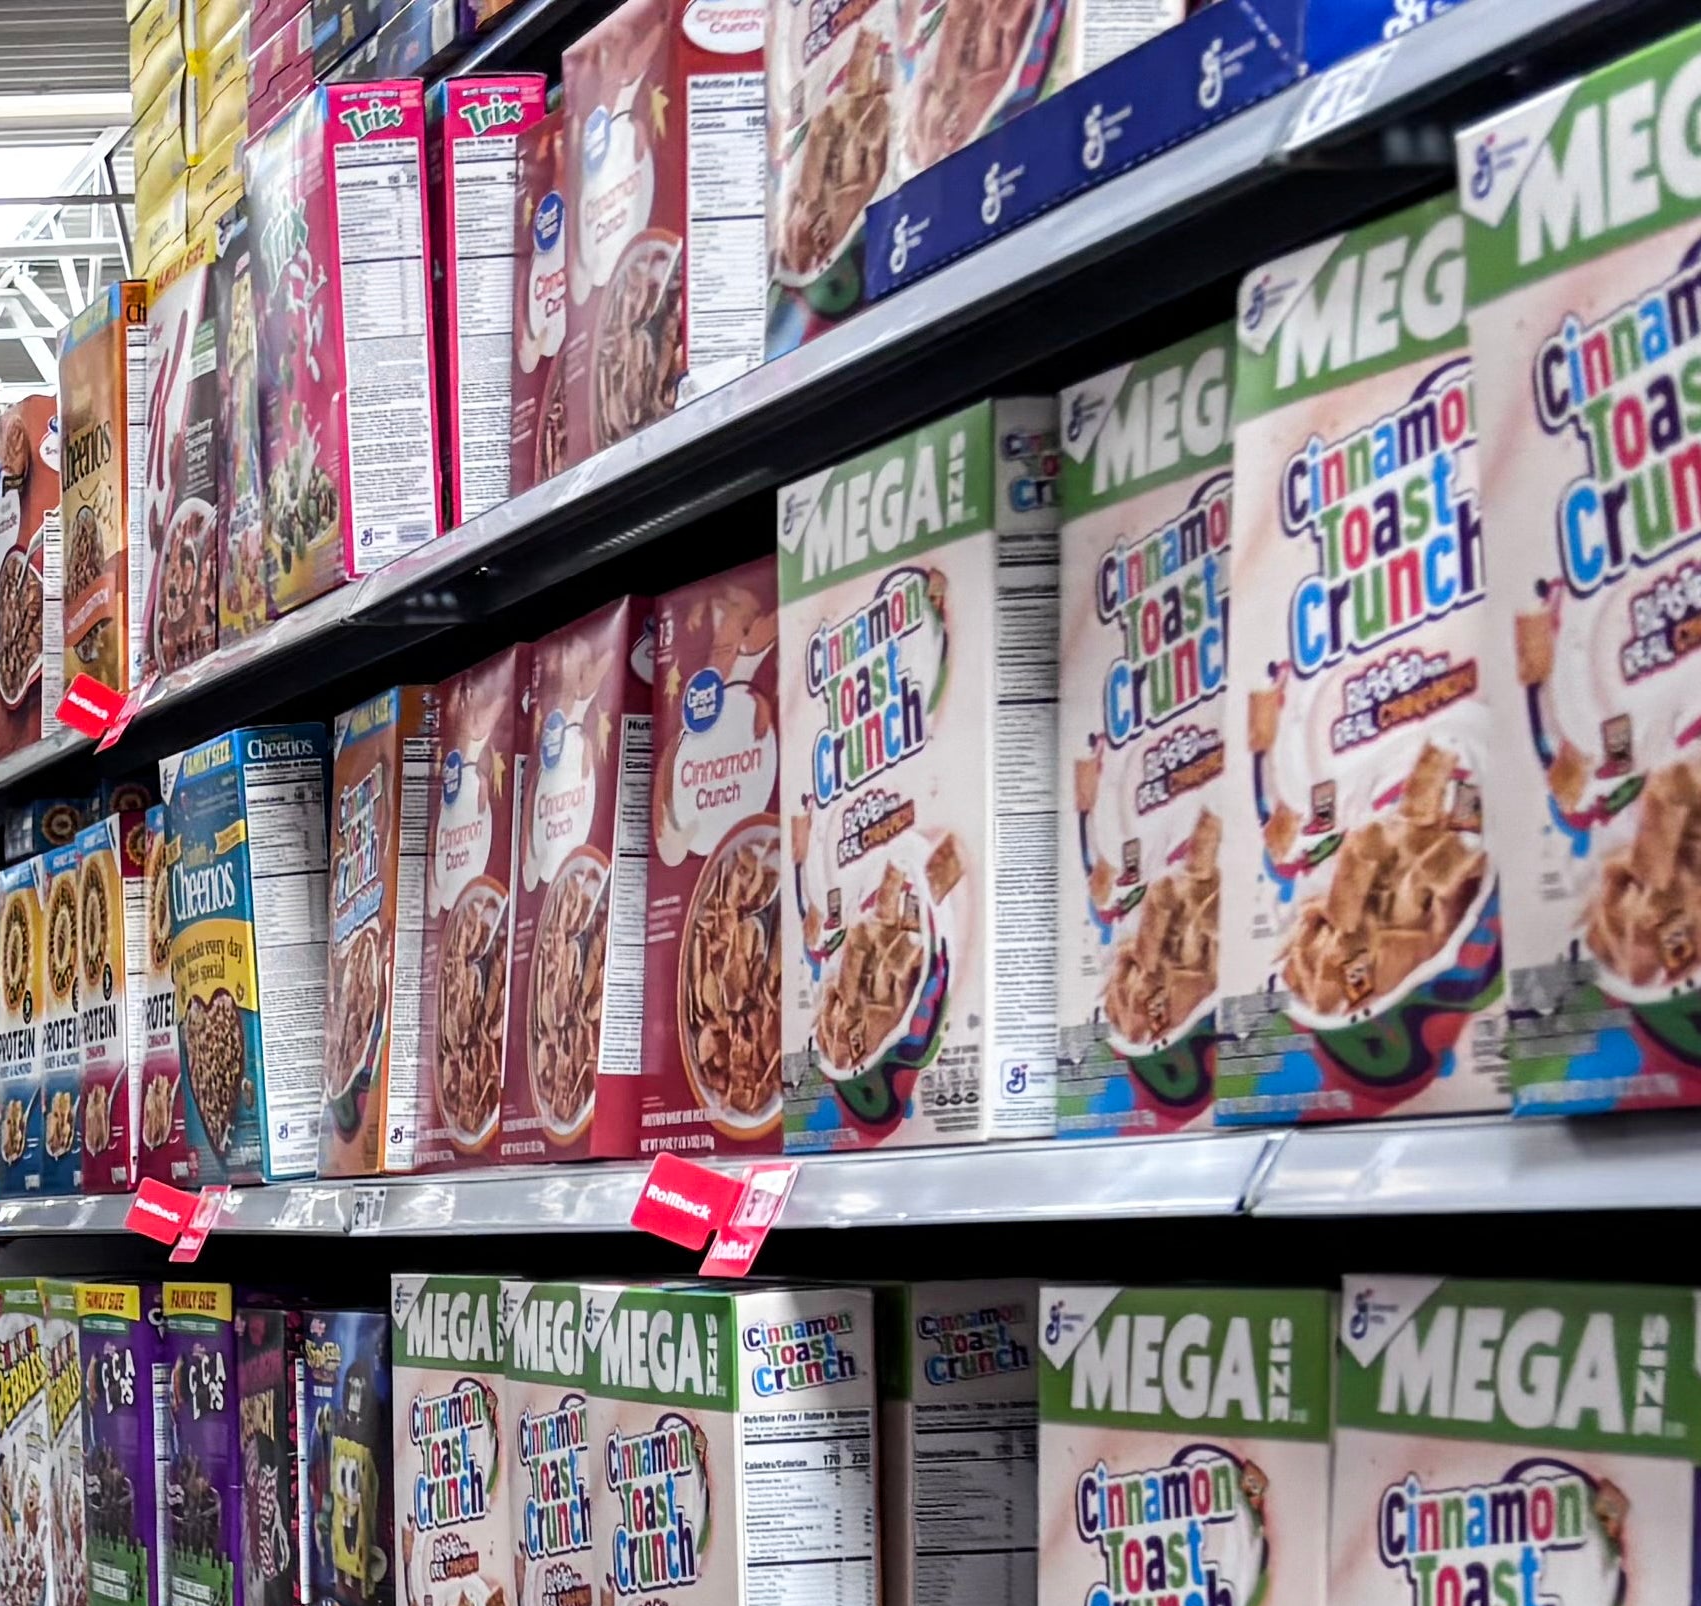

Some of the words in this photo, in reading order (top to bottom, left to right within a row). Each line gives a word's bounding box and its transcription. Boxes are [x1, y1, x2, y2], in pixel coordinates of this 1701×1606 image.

[339, 98, 403, 141] Trix
[459, 94, 524, 136] Trix
[1275, 216, 1465, 389] MEG
[1321, 448, 1451, 582] Toast
[807, 570, 925, 690] Cinnamon
[688, 685, 717, 709] Great
[828, 637, 900, 732] Toast
[1346, 655, 1421, 713] BLASTED
[248, 739, 314, 759] Cheerios
[681, 748, 762, 789] Cinnamon
[815, 684, 925, 803] Crunch
[696, 779, 742, 813] Crunch
[173, 862, 235, 921] Cheerios
[200, 957, 225, 981] special
[205, 939, 227, 955] every
[229, 936, 242, 963] day
[136, 1198, 181, 1223] Rollback
[646, 1182, 712, 1222] Rollback
[406, 1289, 495, 1361] MEGA
[746, 1313, 852, 1352] Cinnamon
[753, 1352, 856, 1396] Crunch
[766, 1341, 835, 1367] Toast
[1071, 1314, 1262, 1422] MEGA
[1270, 1316, 1292, 1421] SIZE
[1378, 1306, 1625, 1433] MEGA
[1632, 1314, 1669, 1435] SIZE
[421, 1428, 468, 1476] Toast
[824, 1455, 840, 1465] 170
[853, 1453, 870, 1464] 230
[619, 1468, 676, 1526] Toast
[1082, 1462, 1237, 1537] Cinnamon
[1384, 1476, 1587, 1560] Cinnamon
[615, 1521, 695, 1594] Crunch
[1109, 1522, 1202, 1596] Toast
